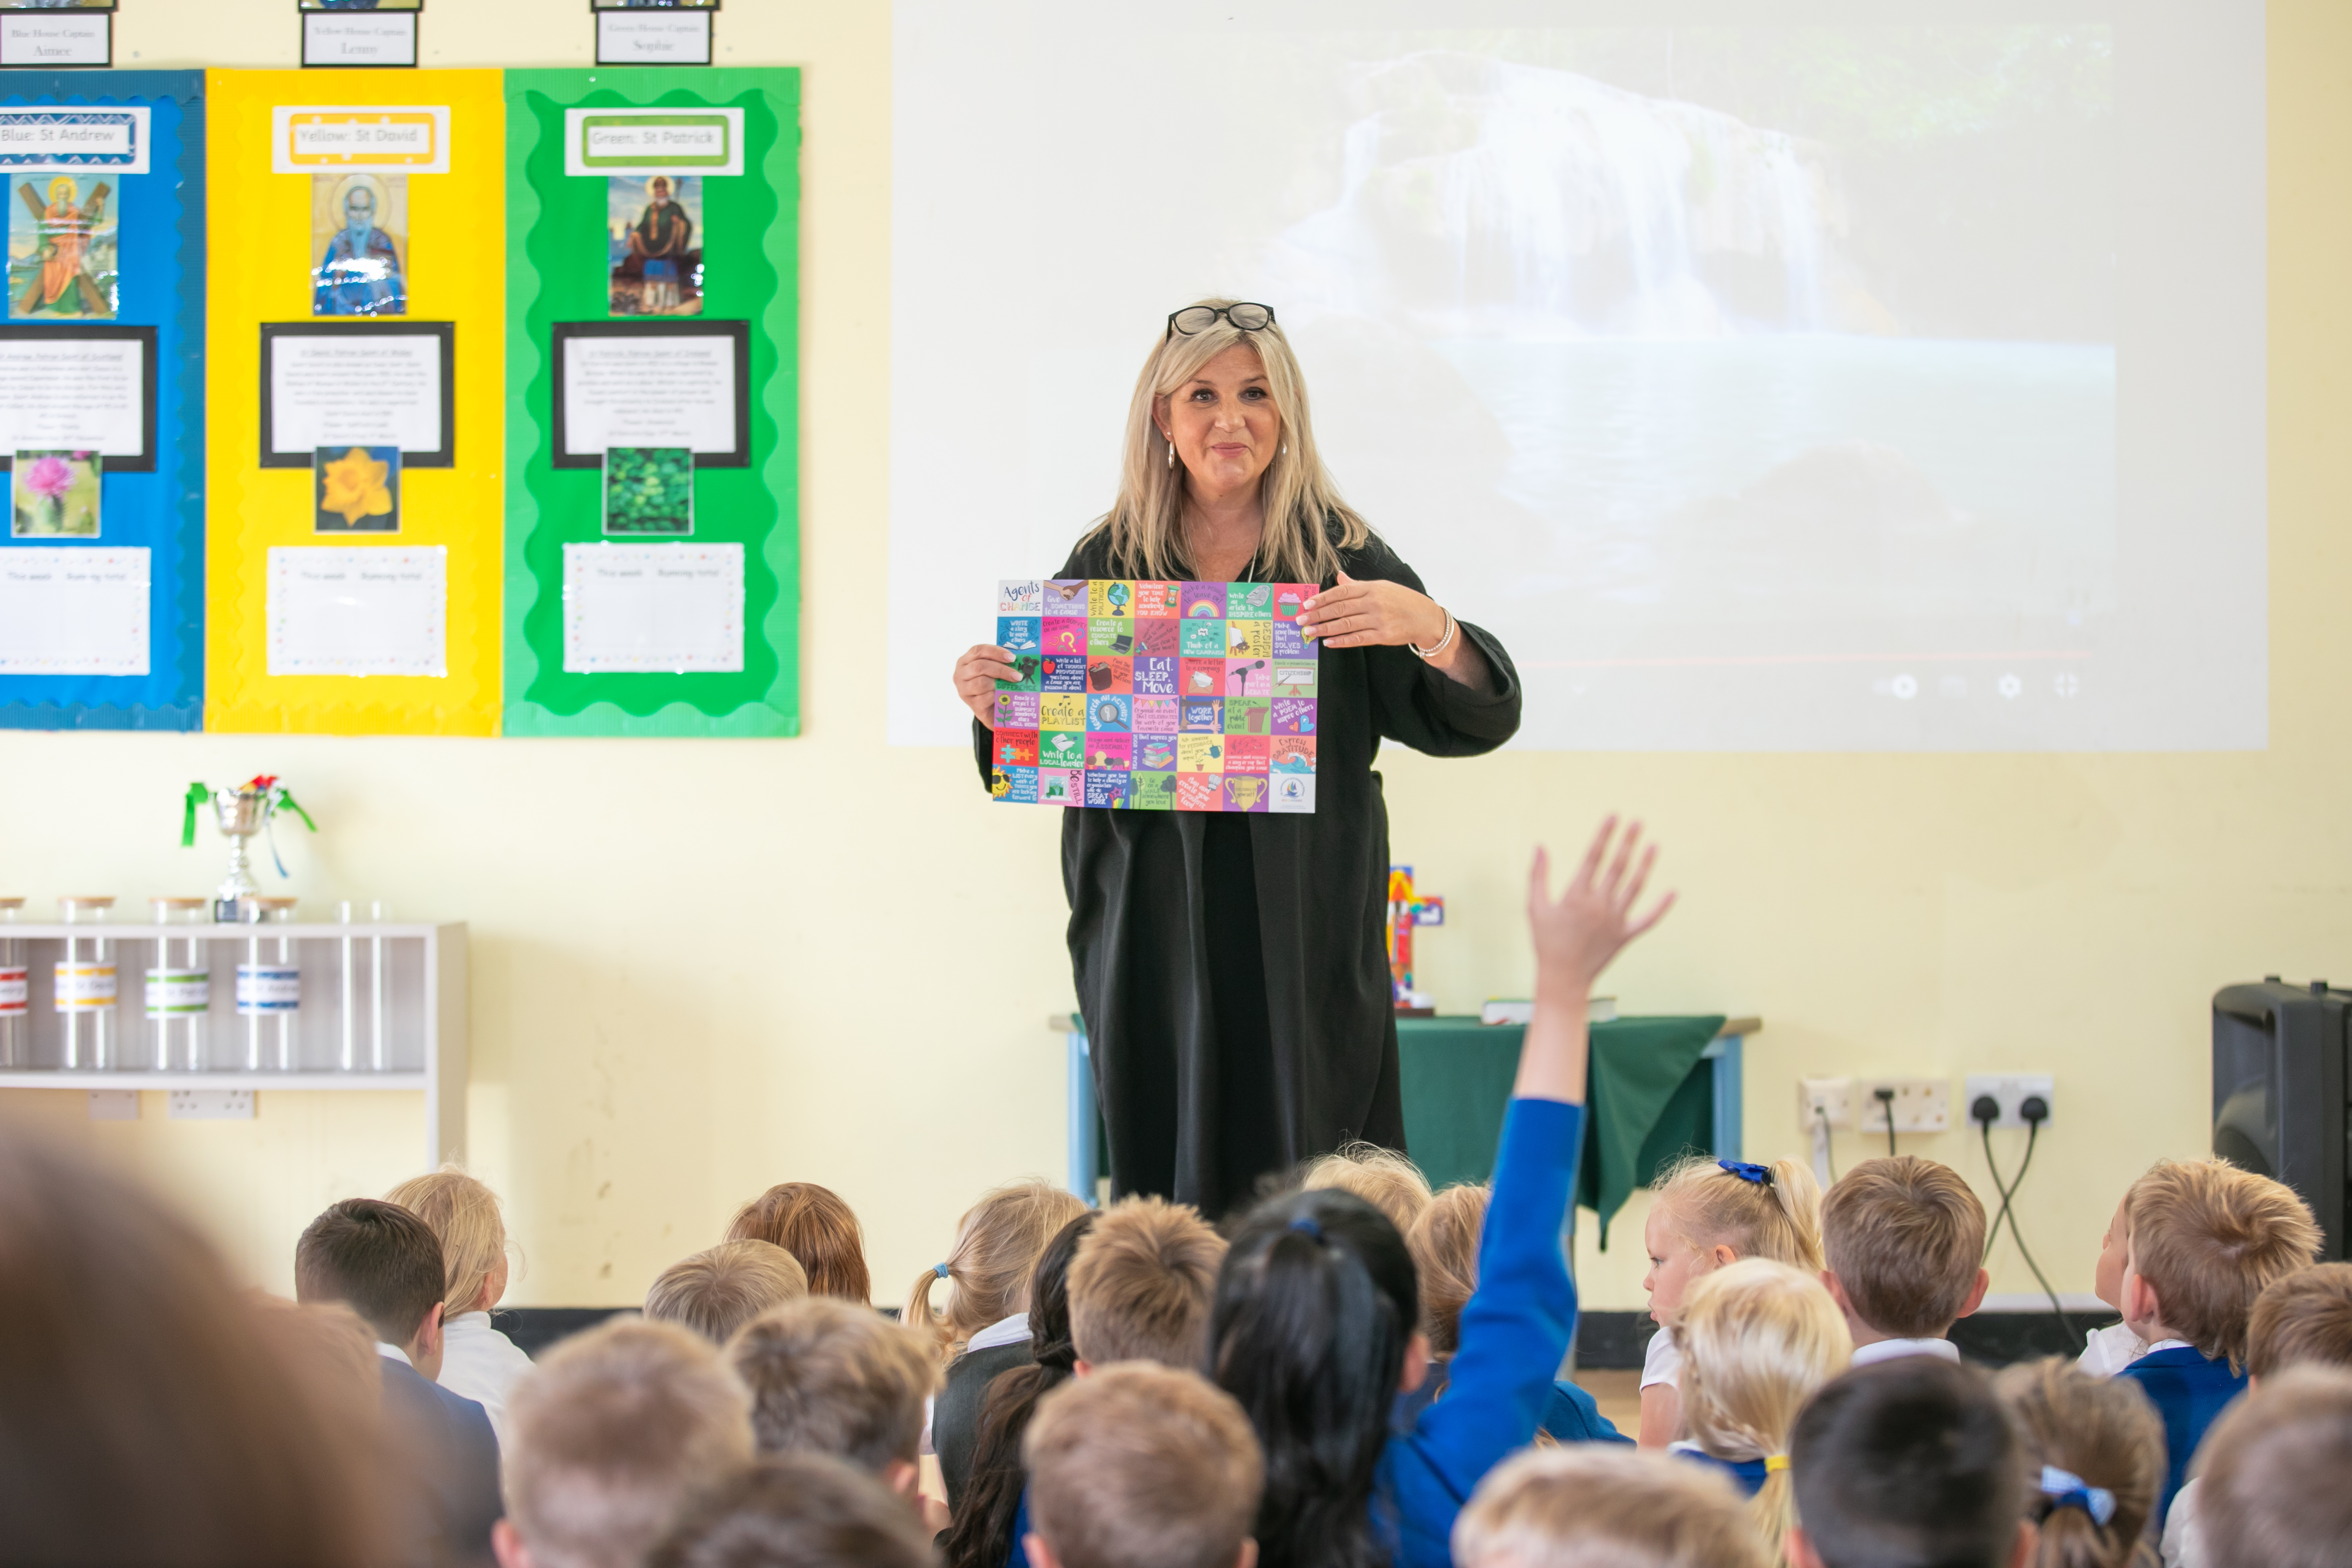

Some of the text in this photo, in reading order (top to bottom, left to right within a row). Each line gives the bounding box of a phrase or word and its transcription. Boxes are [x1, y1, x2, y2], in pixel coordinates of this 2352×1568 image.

[33, 29, 59, 37] House
[63, 29, 95, 39] Captain
[1, 128, 115, 141] Blue: St Andrew
[298, 130, 418, 142] Yellow: St David
[592, 132, 714, 144] Green: St Patrick
[1004, 581, 1039, 601] Agents
[1022, 594, 1032, 602] of
[1213, 595, 1223, 604] out
[1000, 602, 1041, 611] CHANGE
[1250, 631, 1263, 657] poster
[1263, 622, 1271, 657] DESIGN
[1150, 657, 1173, 671] Eat.
[1134, 671, 1171, 683] SLEEP.
[1142, 681, 1176, 693] Move.
[1041, 705, 1074, 716] Create
[1274, 700, 1291, 710] Write
[1279, 704, 1297, 715] POEM
[1089, 699, 1102, 730] Research
[1111, 696, 1128, 722] ACTIVIST
[1188, 714, 1213, 723] together
[1230, 714, 1245, 723] public
[1277, 704, 1314, 723] inspire others
[1042, 717, 1085, 726] PLAYLIST
[1015, 738, 1035, 747] people
[1043, 750, 1064, 759] Write
[1067, 751, 1075, 759] to
[1273, 745, 1315, 760] GRATITUDE
